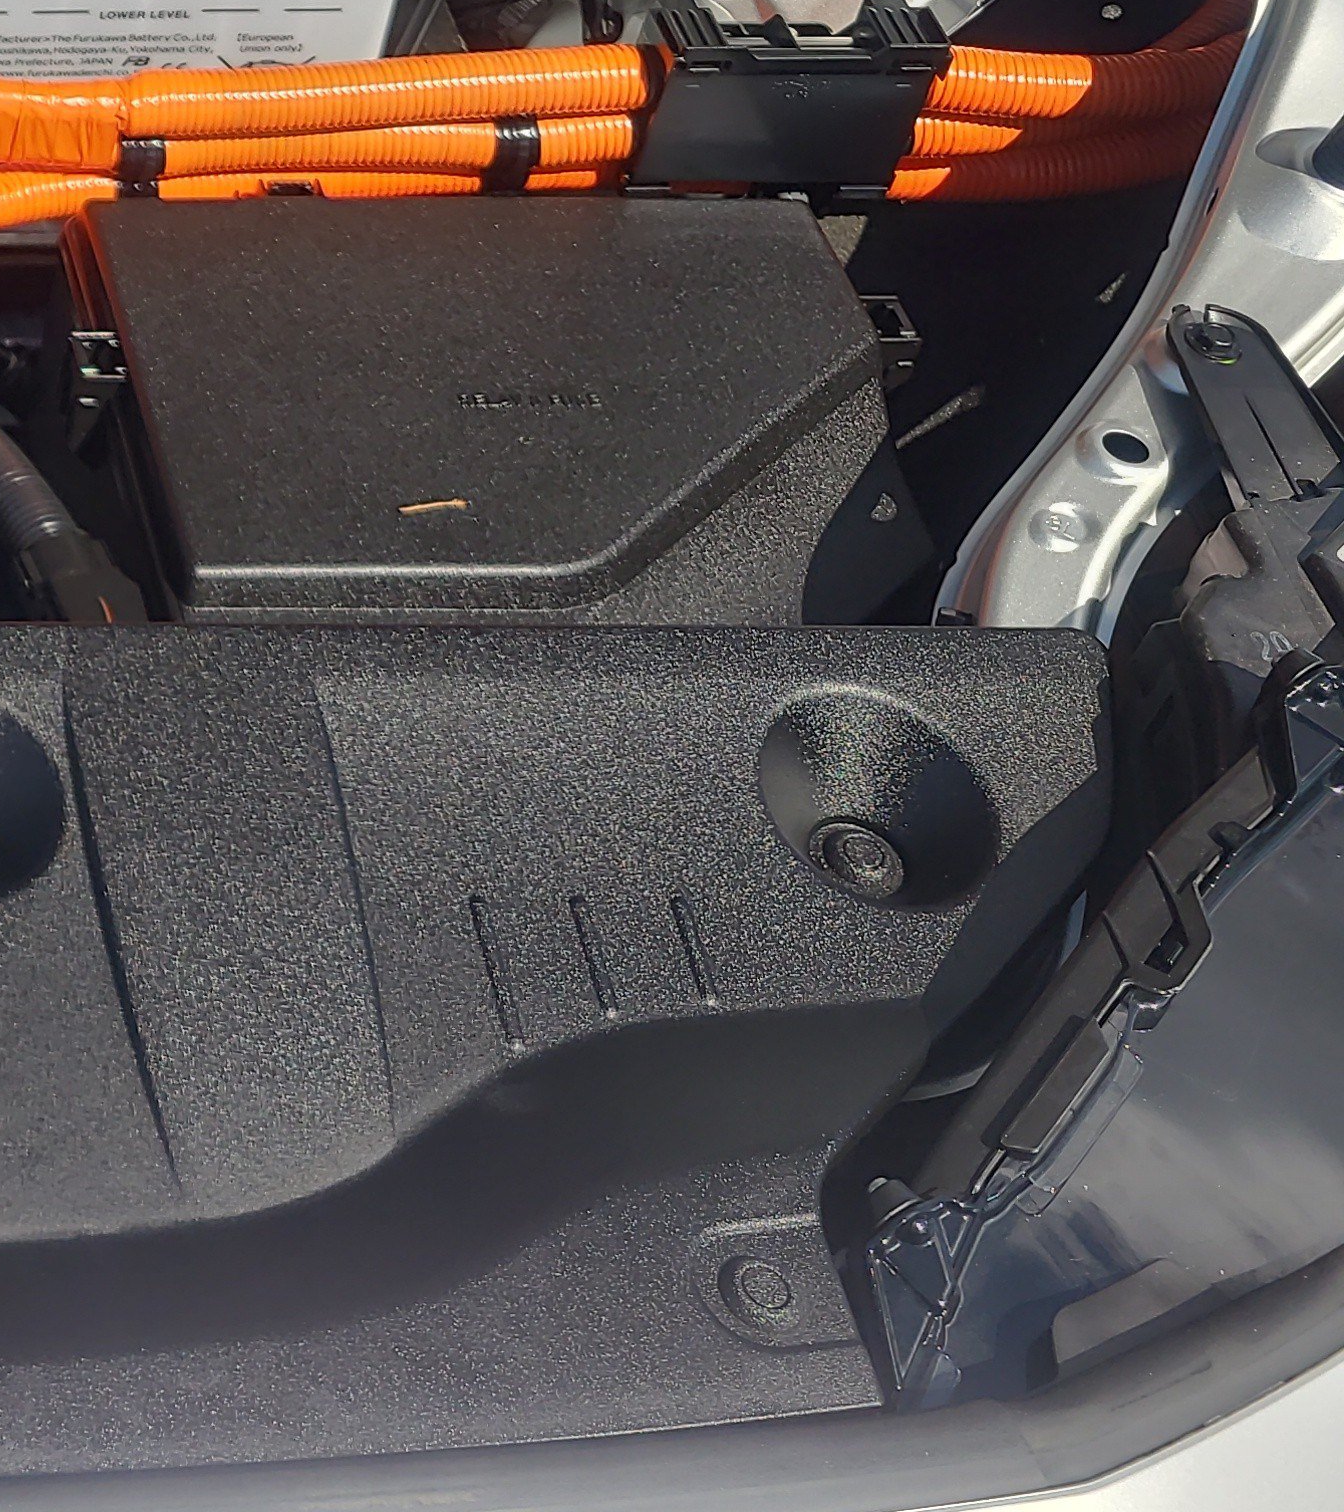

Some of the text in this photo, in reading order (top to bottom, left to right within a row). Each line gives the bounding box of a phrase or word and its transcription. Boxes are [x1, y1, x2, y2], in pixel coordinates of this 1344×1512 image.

[99, 10, 190, 20] LOWER LEVEL
[51, 34, 71, 42] The
[73, 34, 127, 42] Furukawa
[128, 33, 172, 42] Battery
[130, 46, 185, 54] Yokohama
[79, 56, 113, 65] JAPAN
